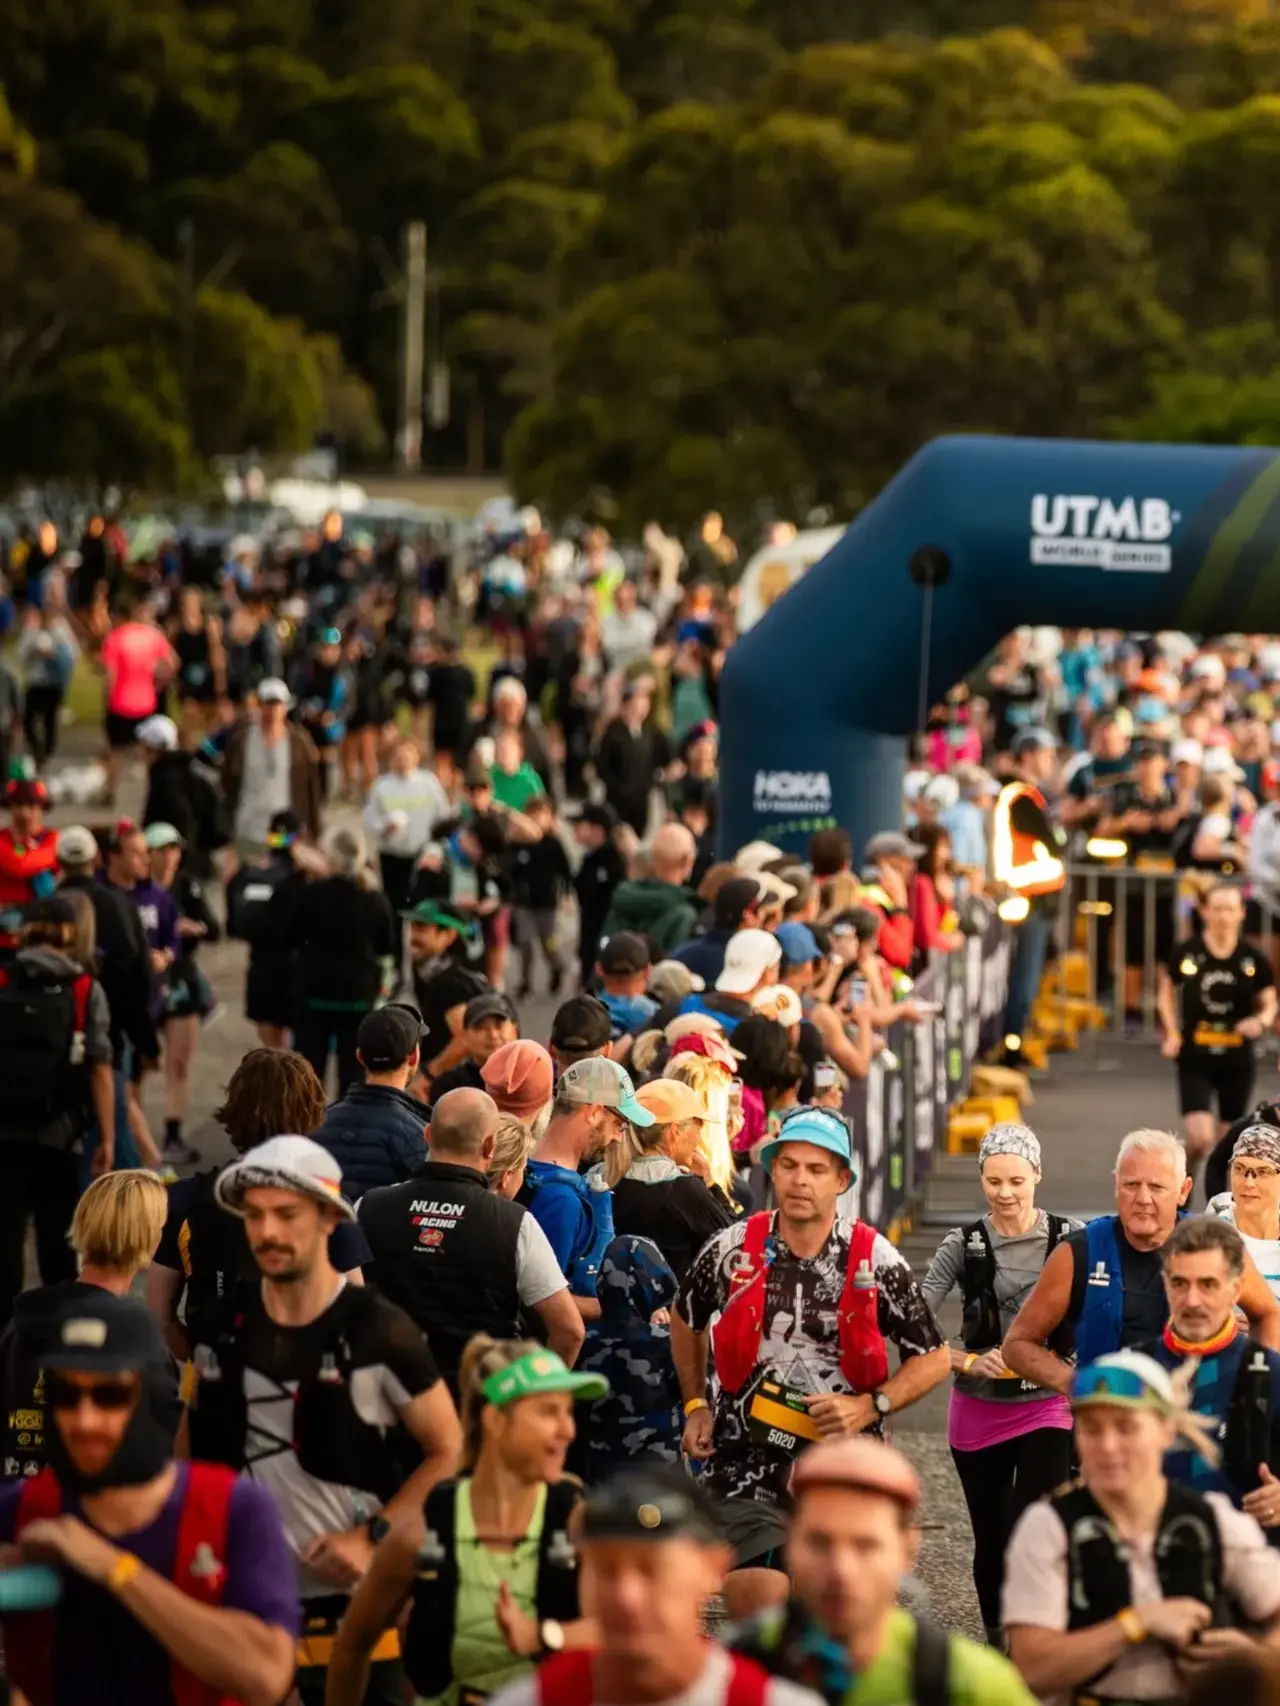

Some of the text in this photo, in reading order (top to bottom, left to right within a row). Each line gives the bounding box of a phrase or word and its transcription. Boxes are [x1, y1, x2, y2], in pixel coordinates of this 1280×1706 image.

[1031, 493, 1173, 541] UTMB
[753, 770, 832, 799] HOKA
[409, 1200, 466, 1216] NULON
[767, 1428, 796, 1450] 5020
